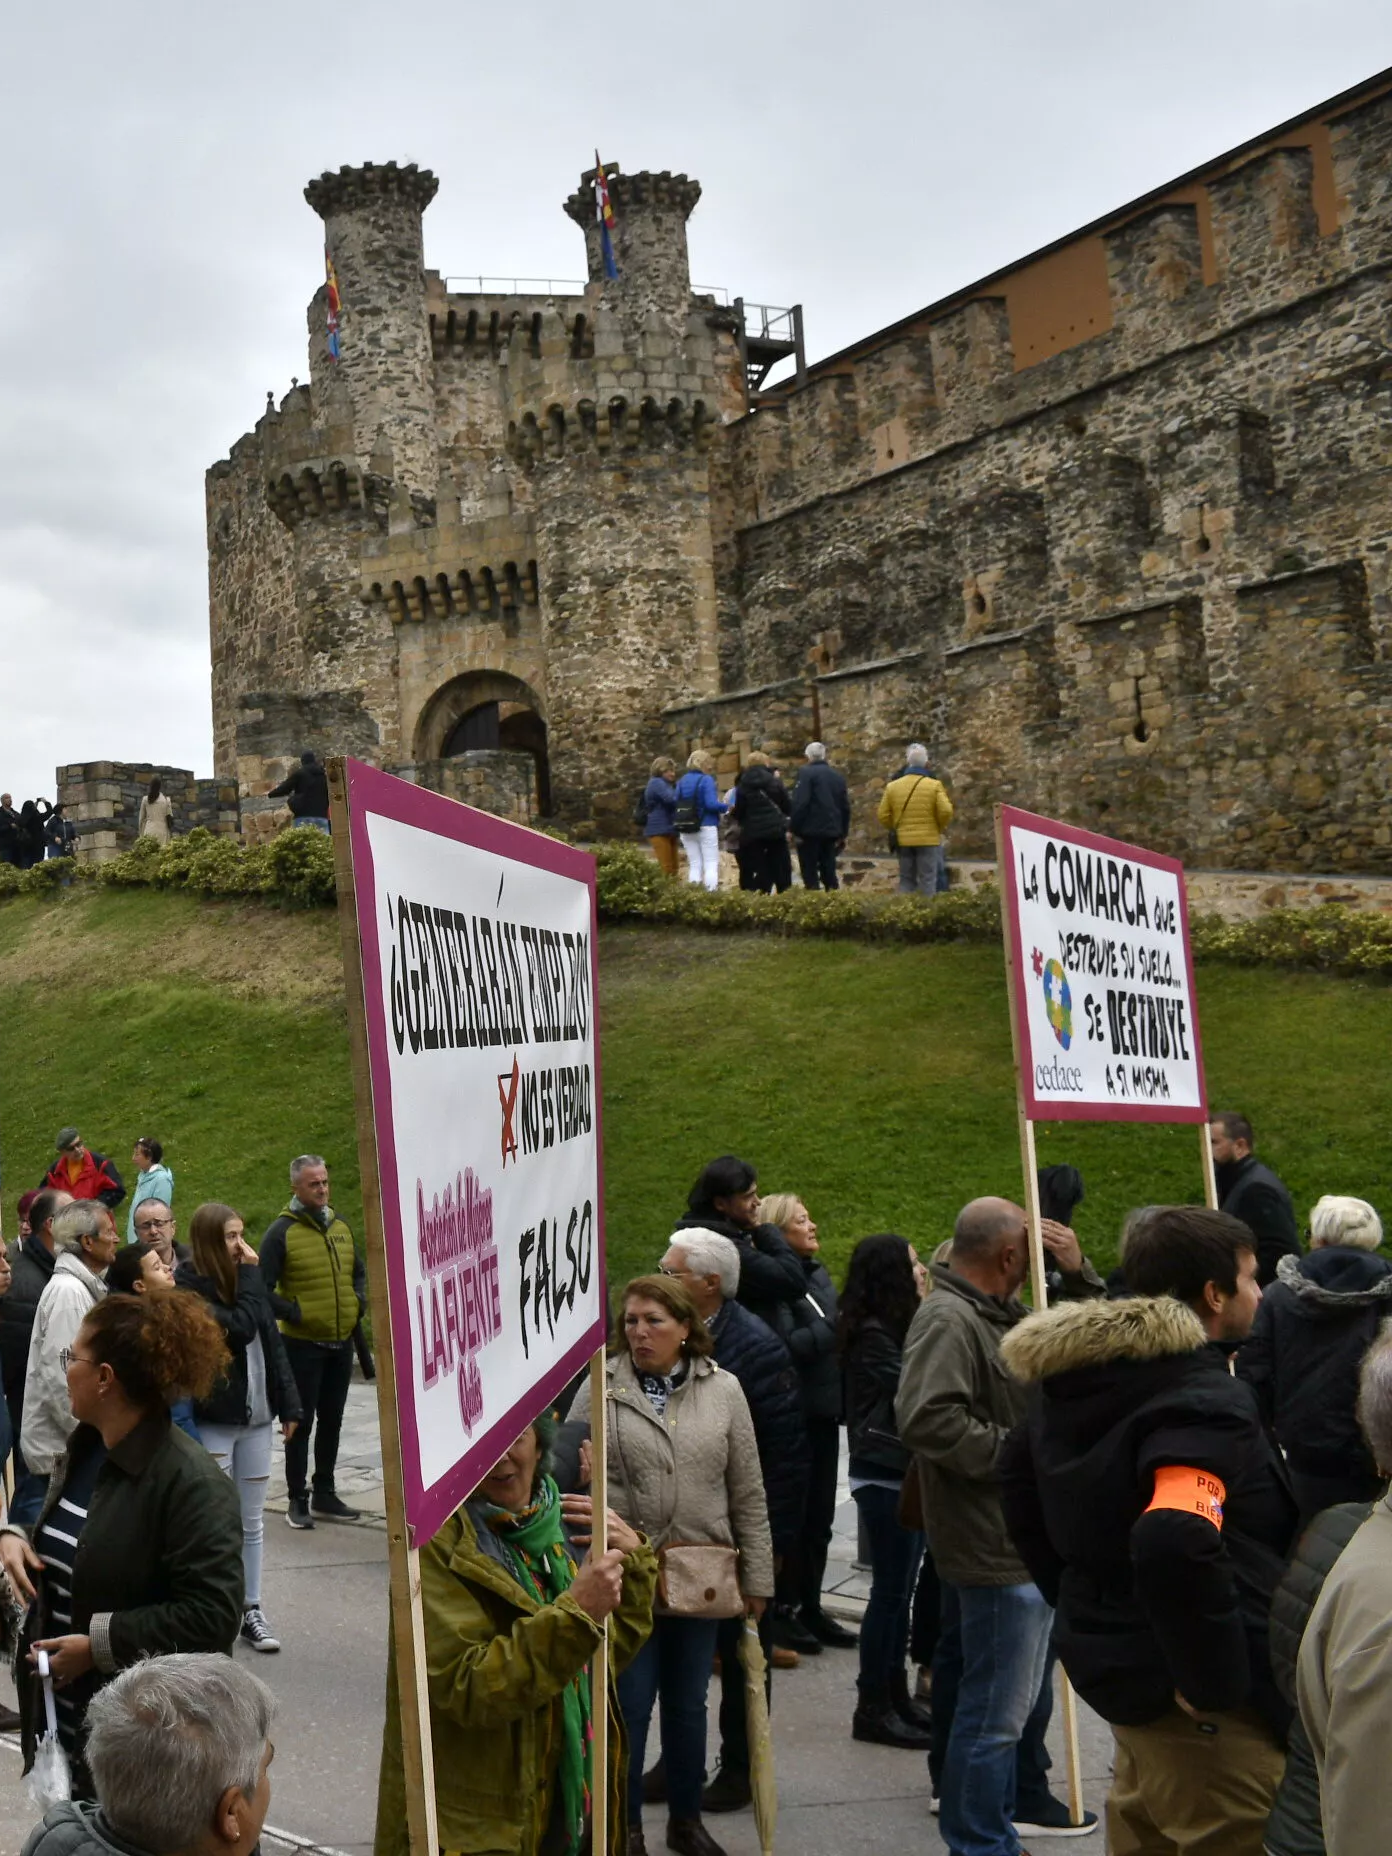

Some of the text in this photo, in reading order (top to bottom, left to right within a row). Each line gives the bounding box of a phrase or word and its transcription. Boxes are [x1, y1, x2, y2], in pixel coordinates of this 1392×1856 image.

[1045, 841, 1149, 929] COMARCA
[1154, 896, 1176, 935] QUE
[387, 871, 529, 1055] ¿GENERARÁN
[1058, 929, 1118, 978] DESTRUYE
[1120, 942, 1134, 980] SU
[1084, 989, 1190, 1061] SE DESTRUYE
[521, 1064, 592, 1155] NO ES VERDAD
[1035, 1055, 1084, 1092] cedace
[1106, 1063, 1116, 1097] A
[1132, 1064, 1170, 1099] MISMA
[466, 1175, 493, 1262] Mujeres
[519, 1200, 593, 1360] FALSO
